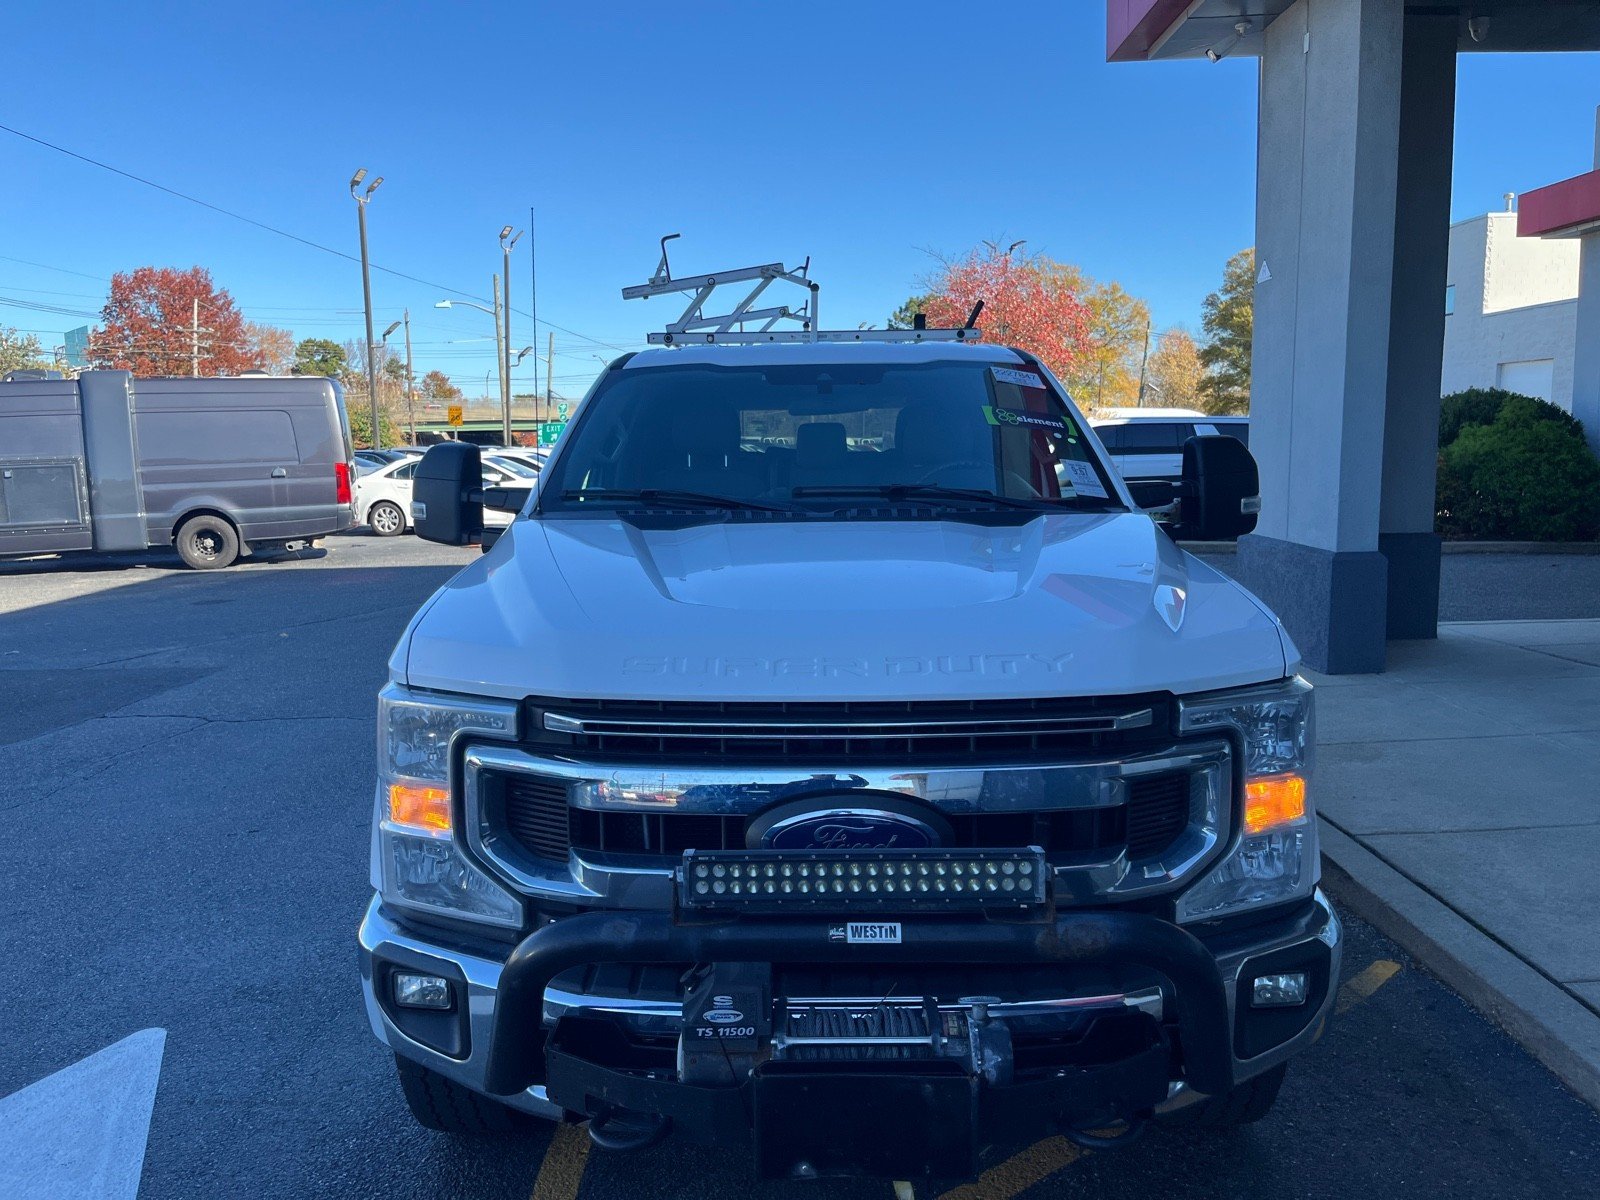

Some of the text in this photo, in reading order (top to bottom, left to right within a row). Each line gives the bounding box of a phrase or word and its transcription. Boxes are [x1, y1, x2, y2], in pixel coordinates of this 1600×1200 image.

[1017, 416, 1065, 428] element
[546, 425, 561, 433] EXIT
[621, 652, 1074, 677] SUPER DUTY
[696, 1027, 755, 1037] TS 11500
